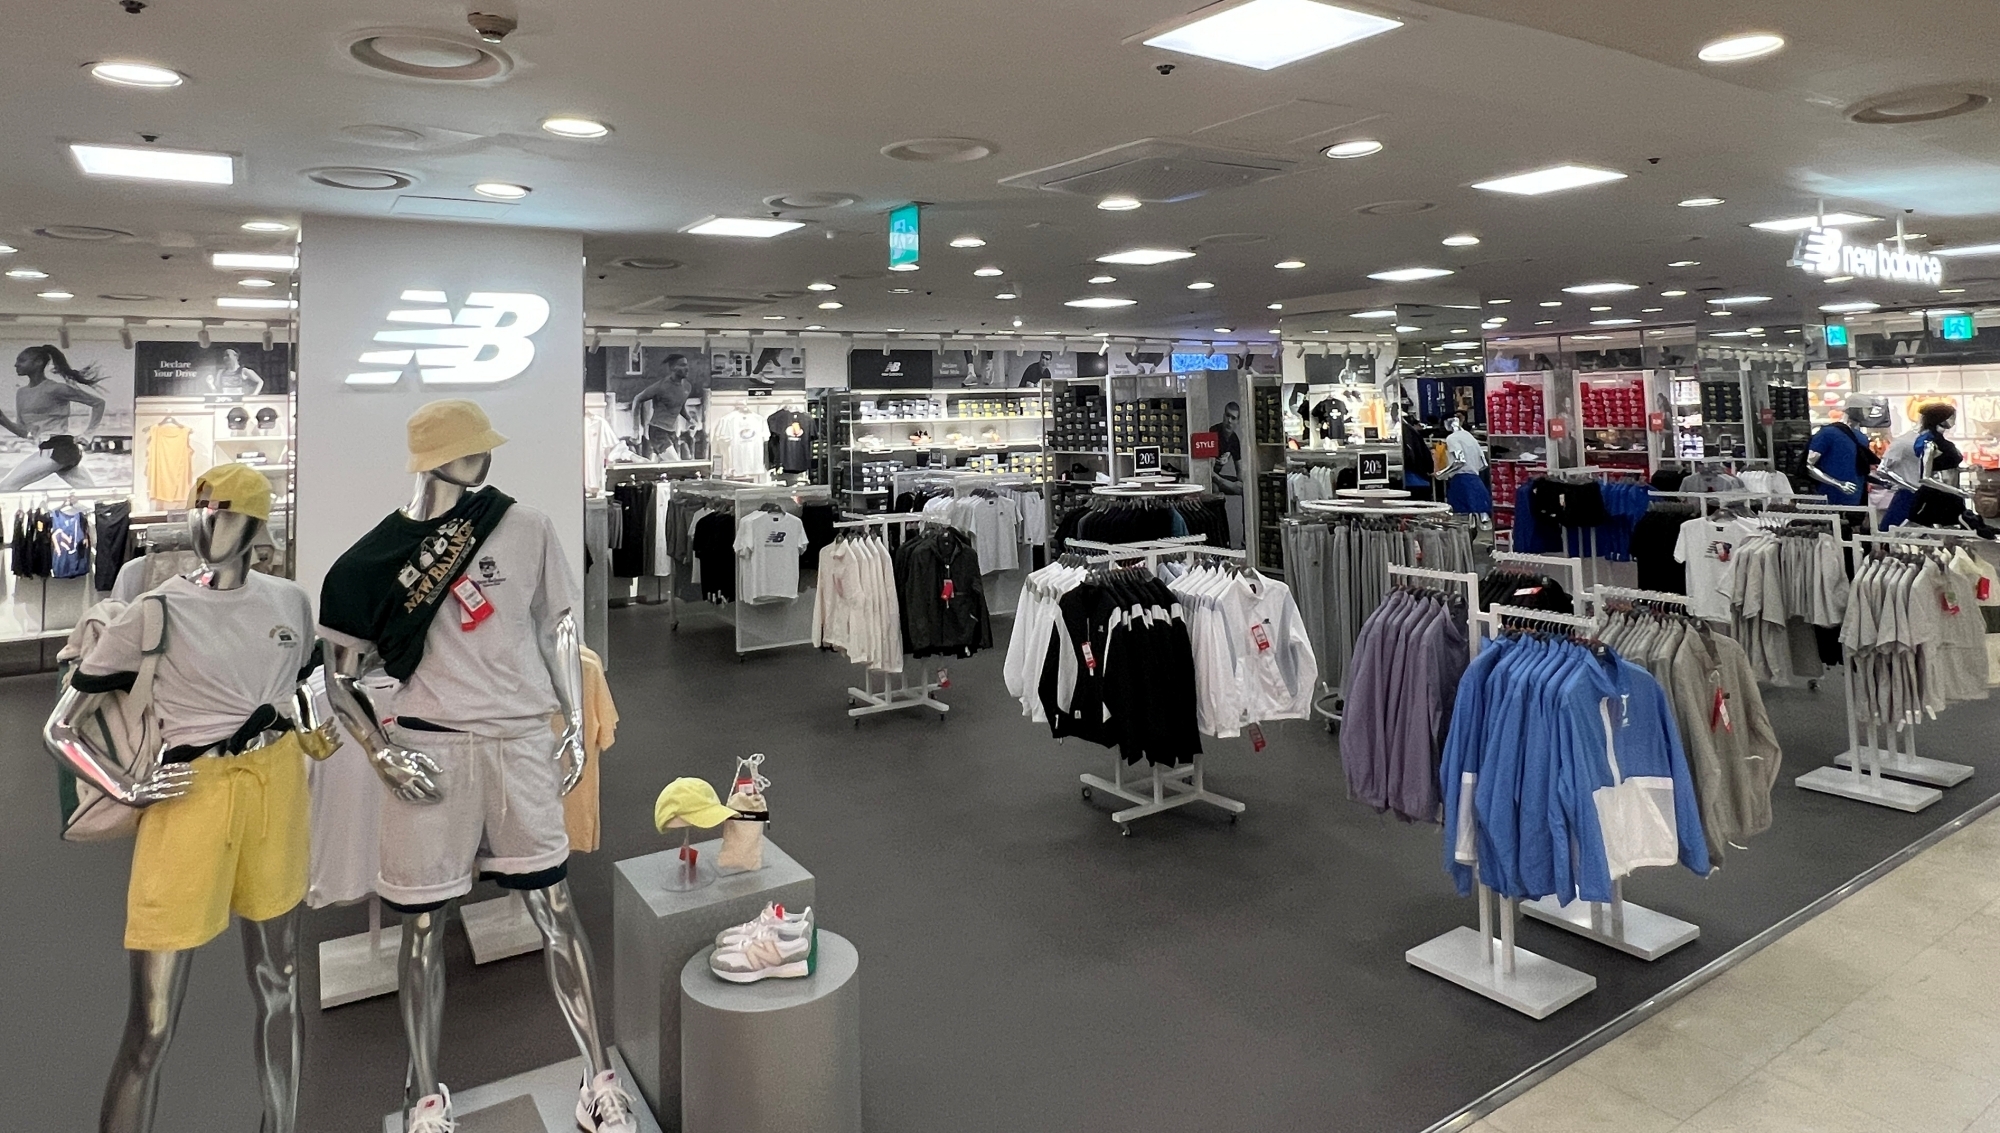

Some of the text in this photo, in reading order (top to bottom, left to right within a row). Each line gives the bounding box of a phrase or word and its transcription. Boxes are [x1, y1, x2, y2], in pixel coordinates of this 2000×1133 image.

[1842, 245, 1877, 275] new
[1877, 242, 1941, 285] balance
[344, 290, 550, 385] NB
[154, 370, 197, 378] Your Drive
[160, 360, 191, 368] Declare
[1195, 440, 1215, 449] STYLE
[404, 574, 435, 614] NEW
